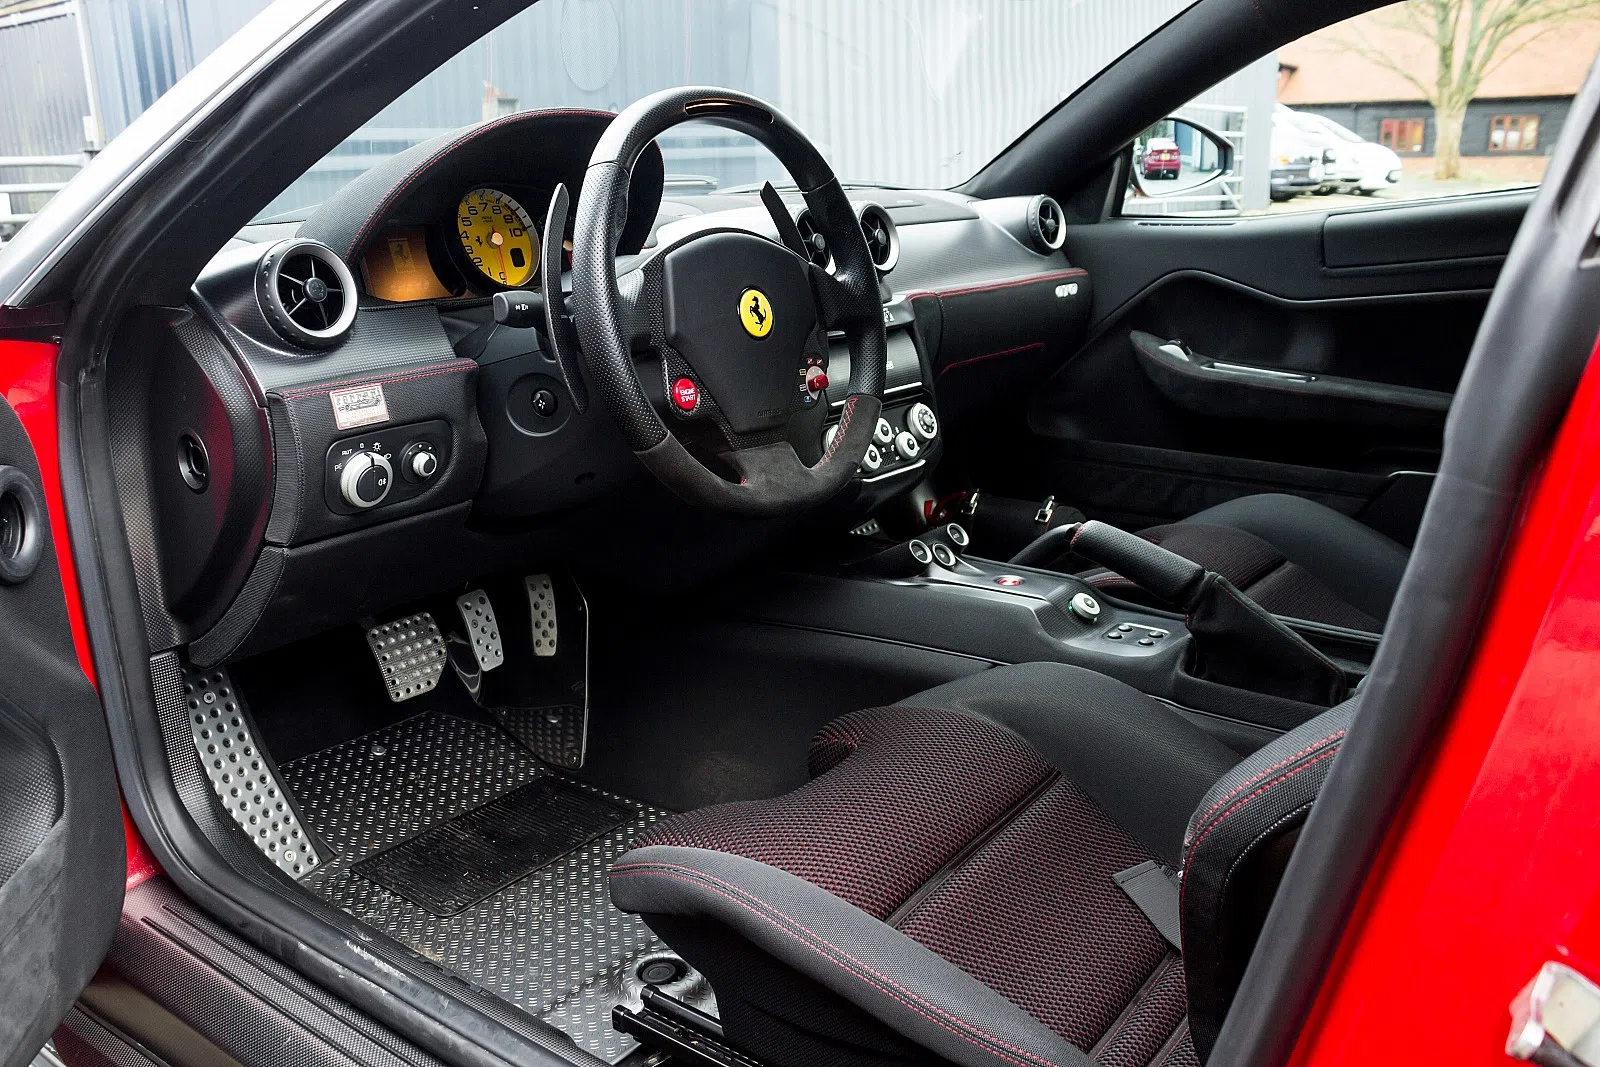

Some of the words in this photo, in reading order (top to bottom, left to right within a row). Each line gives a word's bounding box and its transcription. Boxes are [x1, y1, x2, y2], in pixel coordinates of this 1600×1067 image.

[468, 206, 478, 216] 6
[479, 202, 488, 212] 7
[492, 205, 502, 215] 8
[461, 217, 472, 227] 5
[504, 214, 514, 224] 9
[460, 230, 469, 240] 4
[509, 228, 523, 237] 10
[473, 257, 483, 267] 2
[487, 267, 492, 276] 1
[680, 394, 696, 403] START
